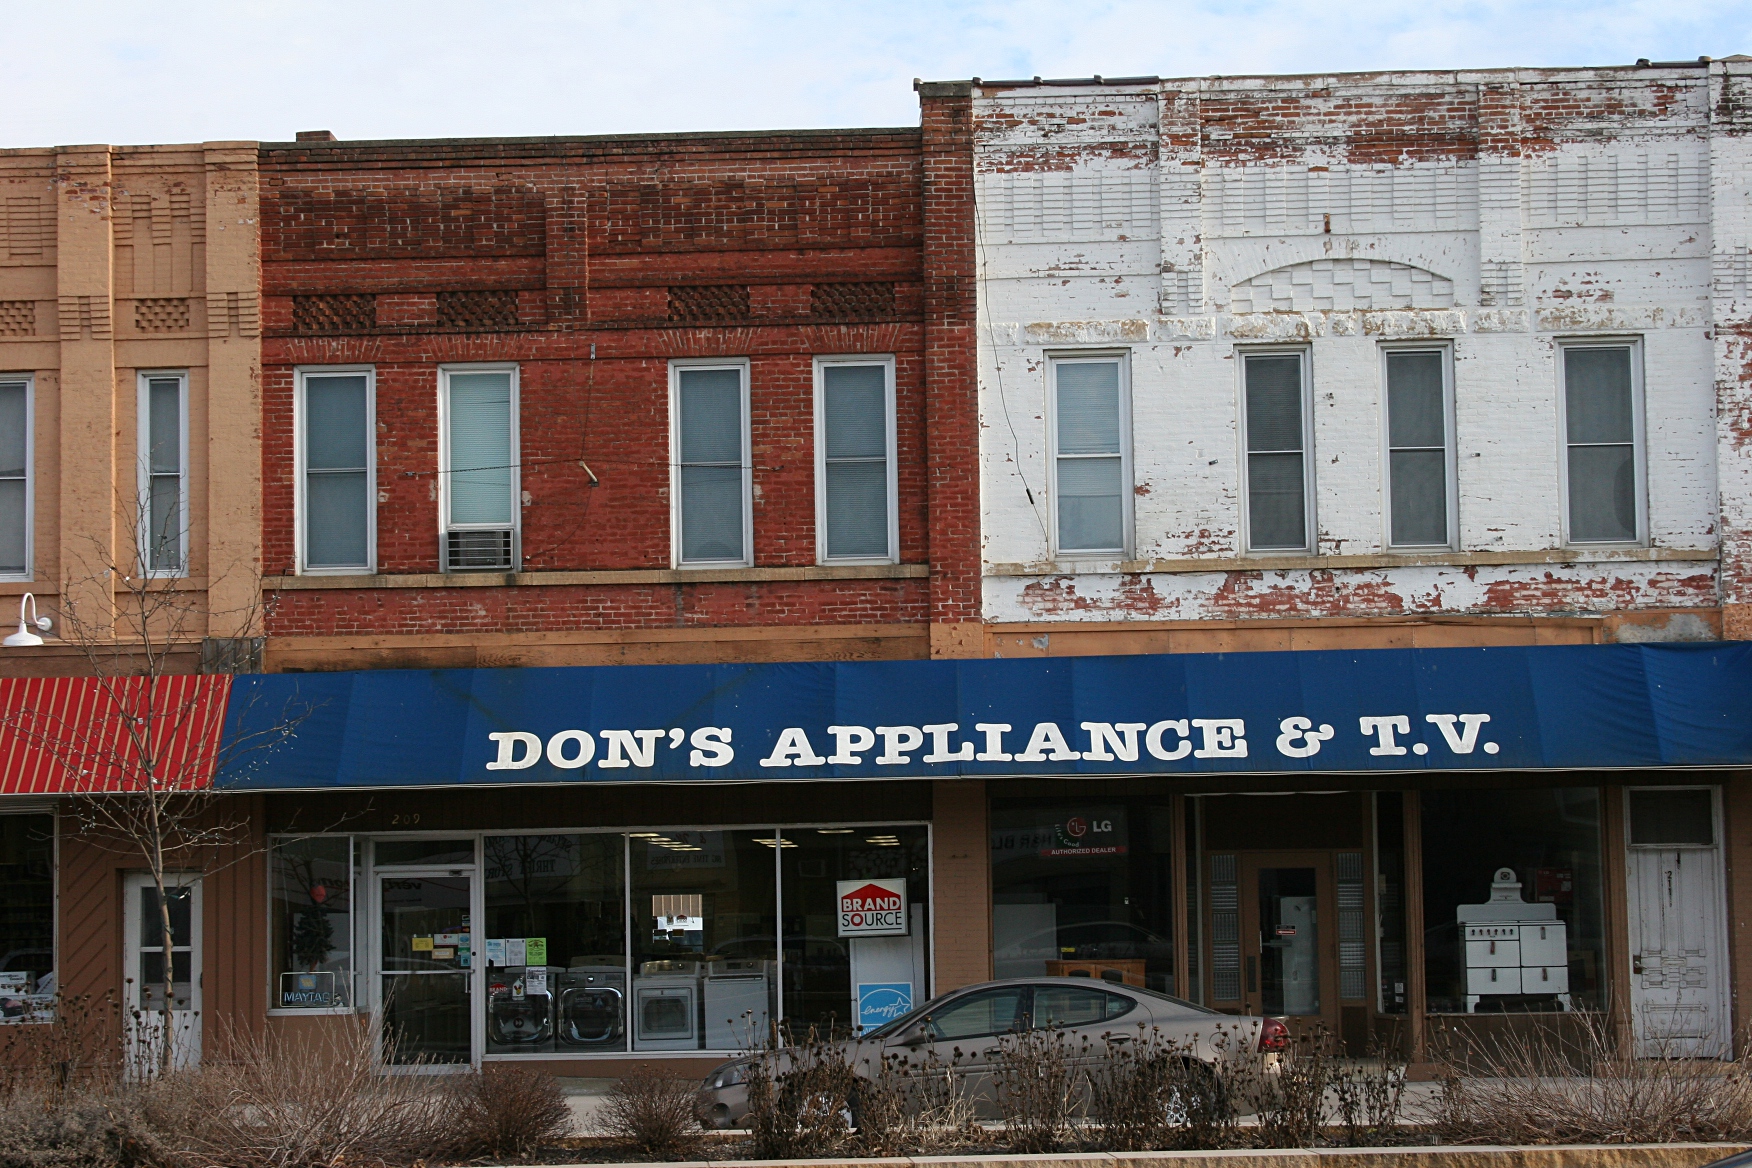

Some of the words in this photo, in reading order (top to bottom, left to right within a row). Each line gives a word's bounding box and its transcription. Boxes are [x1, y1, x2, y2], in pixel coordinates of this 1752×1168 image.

[485, 726, 735, 771] DON'S
[759, 718, 1249, 768] APPLIANCE
[1275, 716, 1335, 758] &
[1358, 713, 1500, 757] T.V.
[391, 813, 421, 825] 209
[1092, 820, 1112, 833] LG
[1051, 848, 1091, 856] AUTHORIZED
[1091, 846, 1117, 854] DEALER
[842, 897, 902, 912] BRAND
[842, 912, 903, 927] SOURCE
[283, 992, 330, 1003] MAYTAG
[861, 1003, 899, 1018] energy
